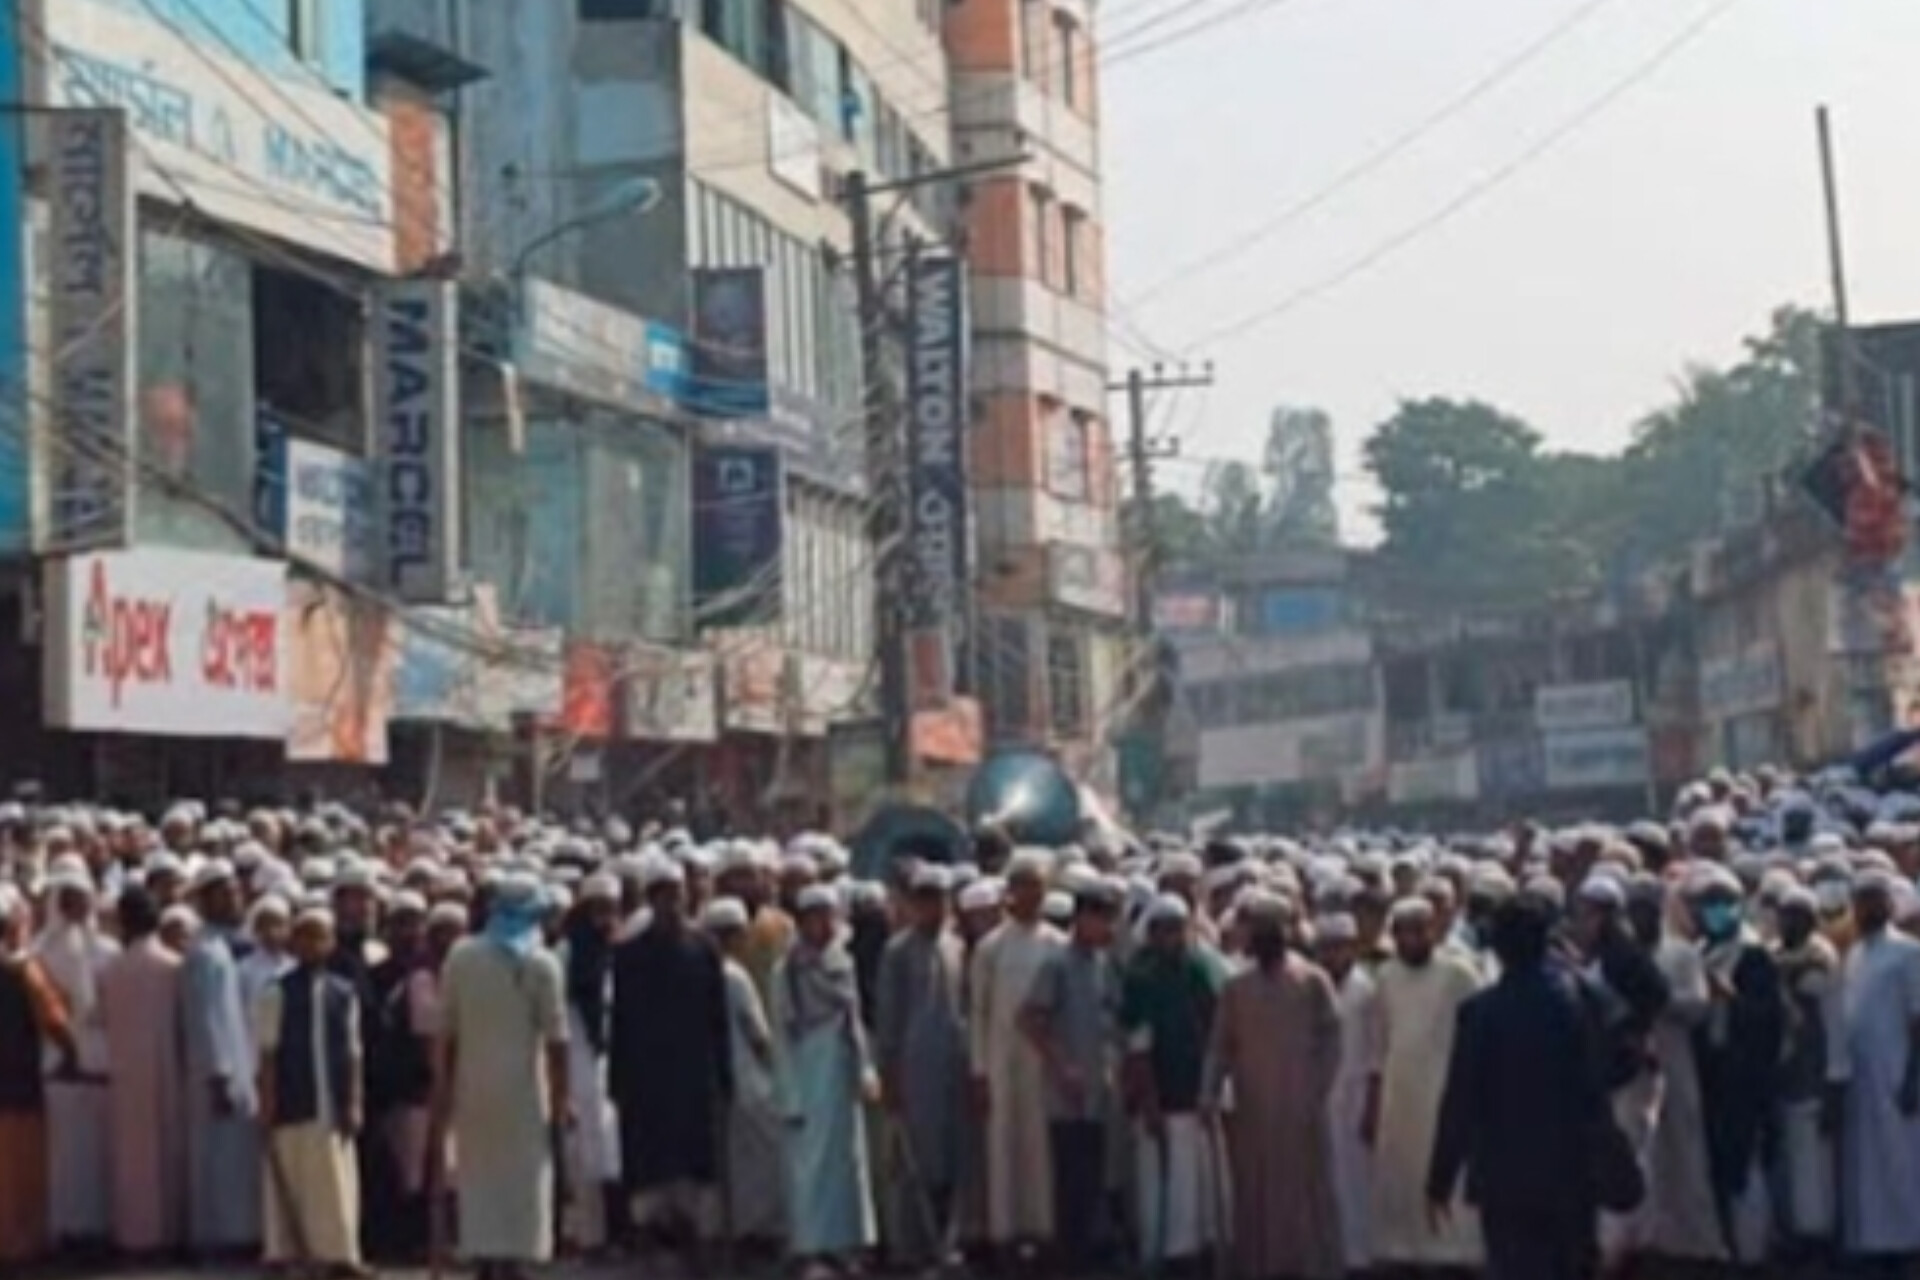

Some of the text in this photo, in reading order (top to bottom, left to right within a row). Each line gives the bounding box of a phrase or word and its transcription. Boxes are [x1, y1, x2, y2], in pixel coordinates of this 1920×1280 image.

[388, 300, 430, 583] MARCEL
[915, 271, 953, 464] WALTON
[83, 557, 171, 709] Apex
